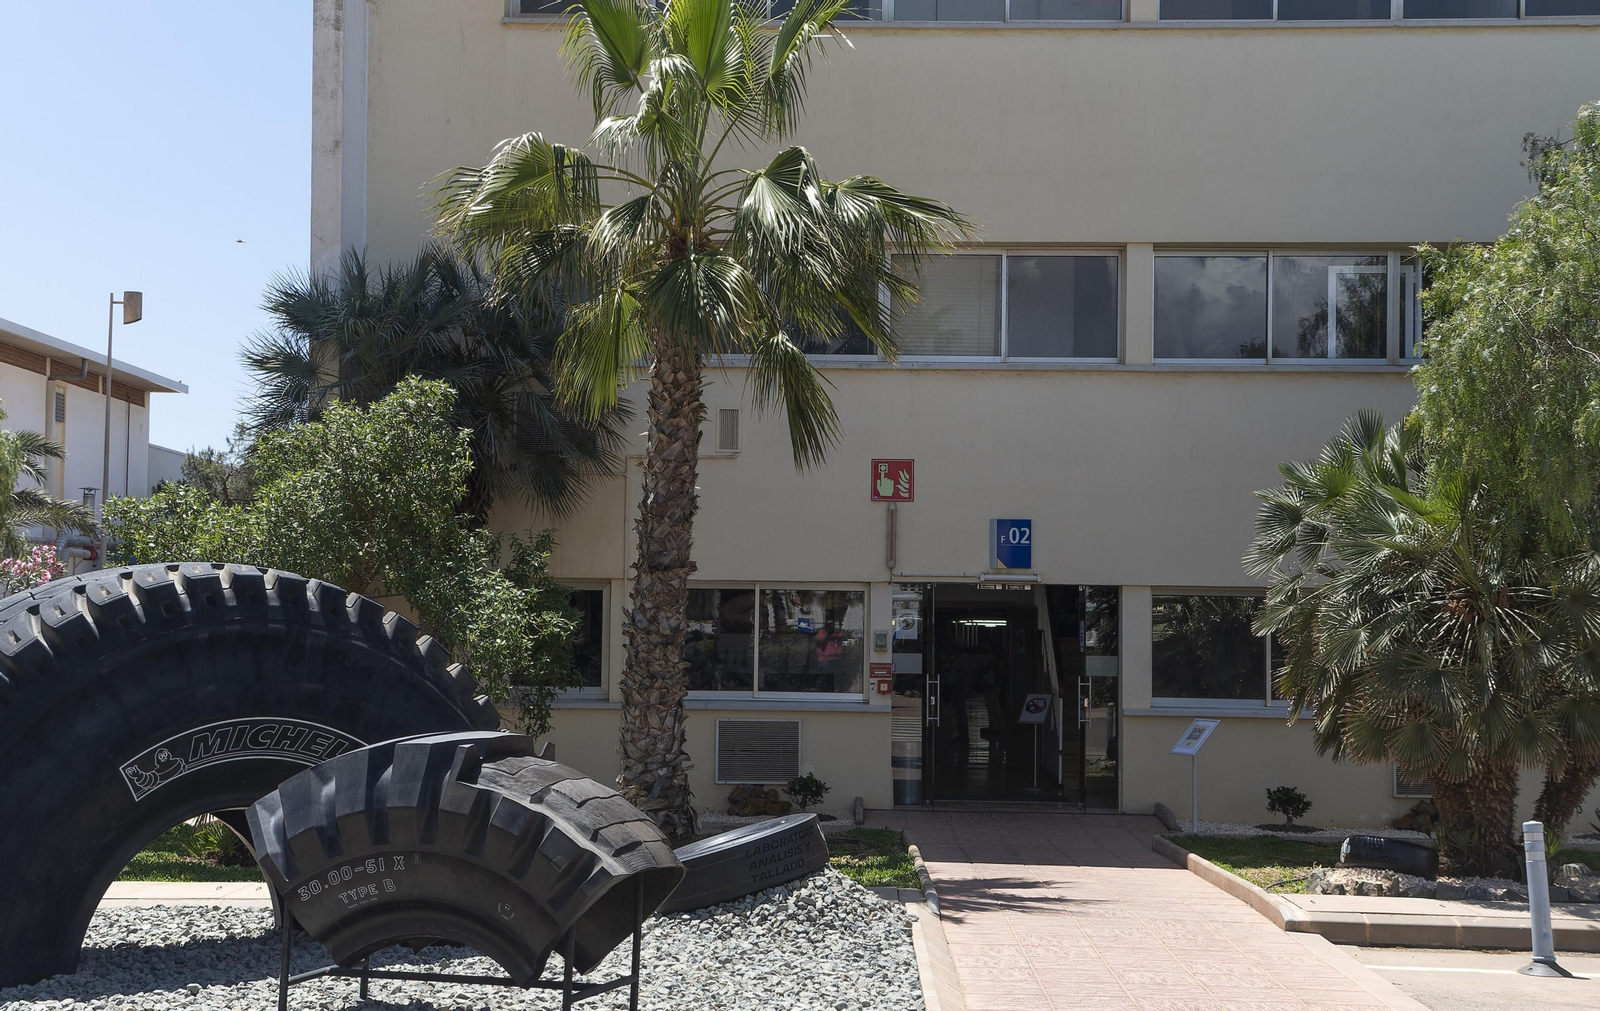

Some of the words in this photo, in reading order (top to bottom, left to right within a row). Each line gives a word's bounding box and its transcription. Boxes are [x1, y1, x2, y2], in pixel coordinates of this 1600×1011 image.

[1000, 535, 1006, 544] F
[1009, 527, 1030, 544] 02
[393, 855, 405, 870] X
[748, 844, 803, 871] ANALISIS
[804, 841, 811, 851] Y
[750, 858, 805, 884] TALLADO
[338, 883, 379, 904] TYPE
[382, 878, 397, 892] B
